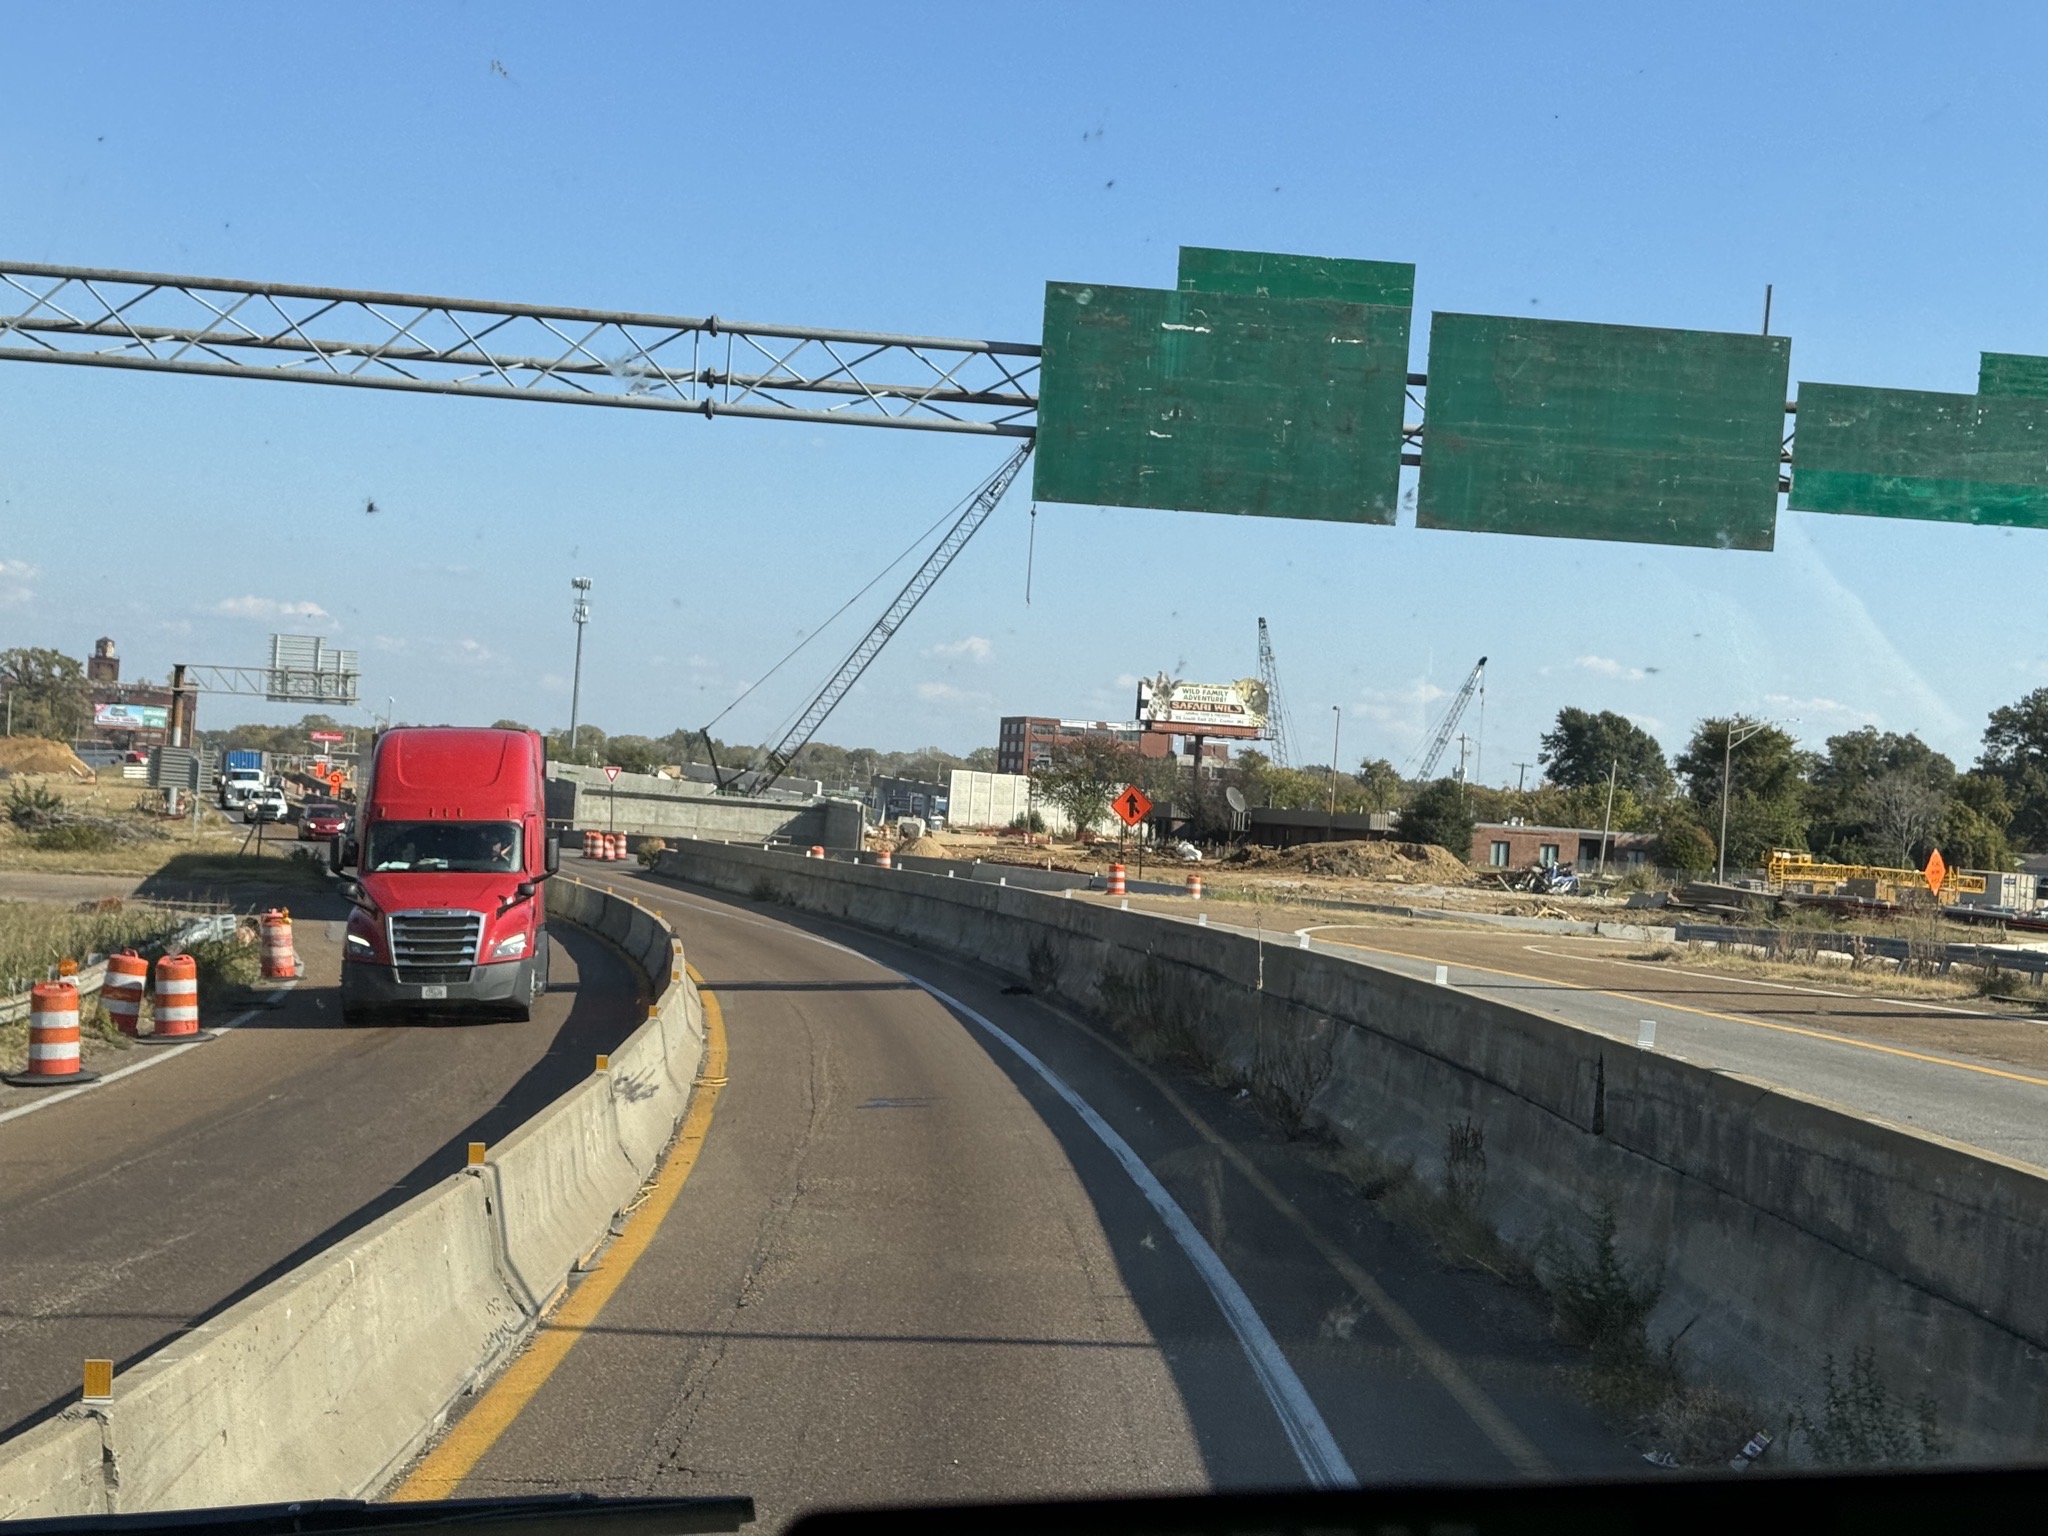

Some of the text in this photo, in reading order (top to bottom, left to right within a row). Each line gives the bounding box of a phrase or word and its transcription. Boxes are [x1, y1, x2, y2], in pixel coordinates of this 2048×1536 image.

[1202, 689, 1228, 697] FAMILY
[1183, 694, 1227, 703] ADVENTURE!
[1171, 701, 1211, 711] SAFARI
